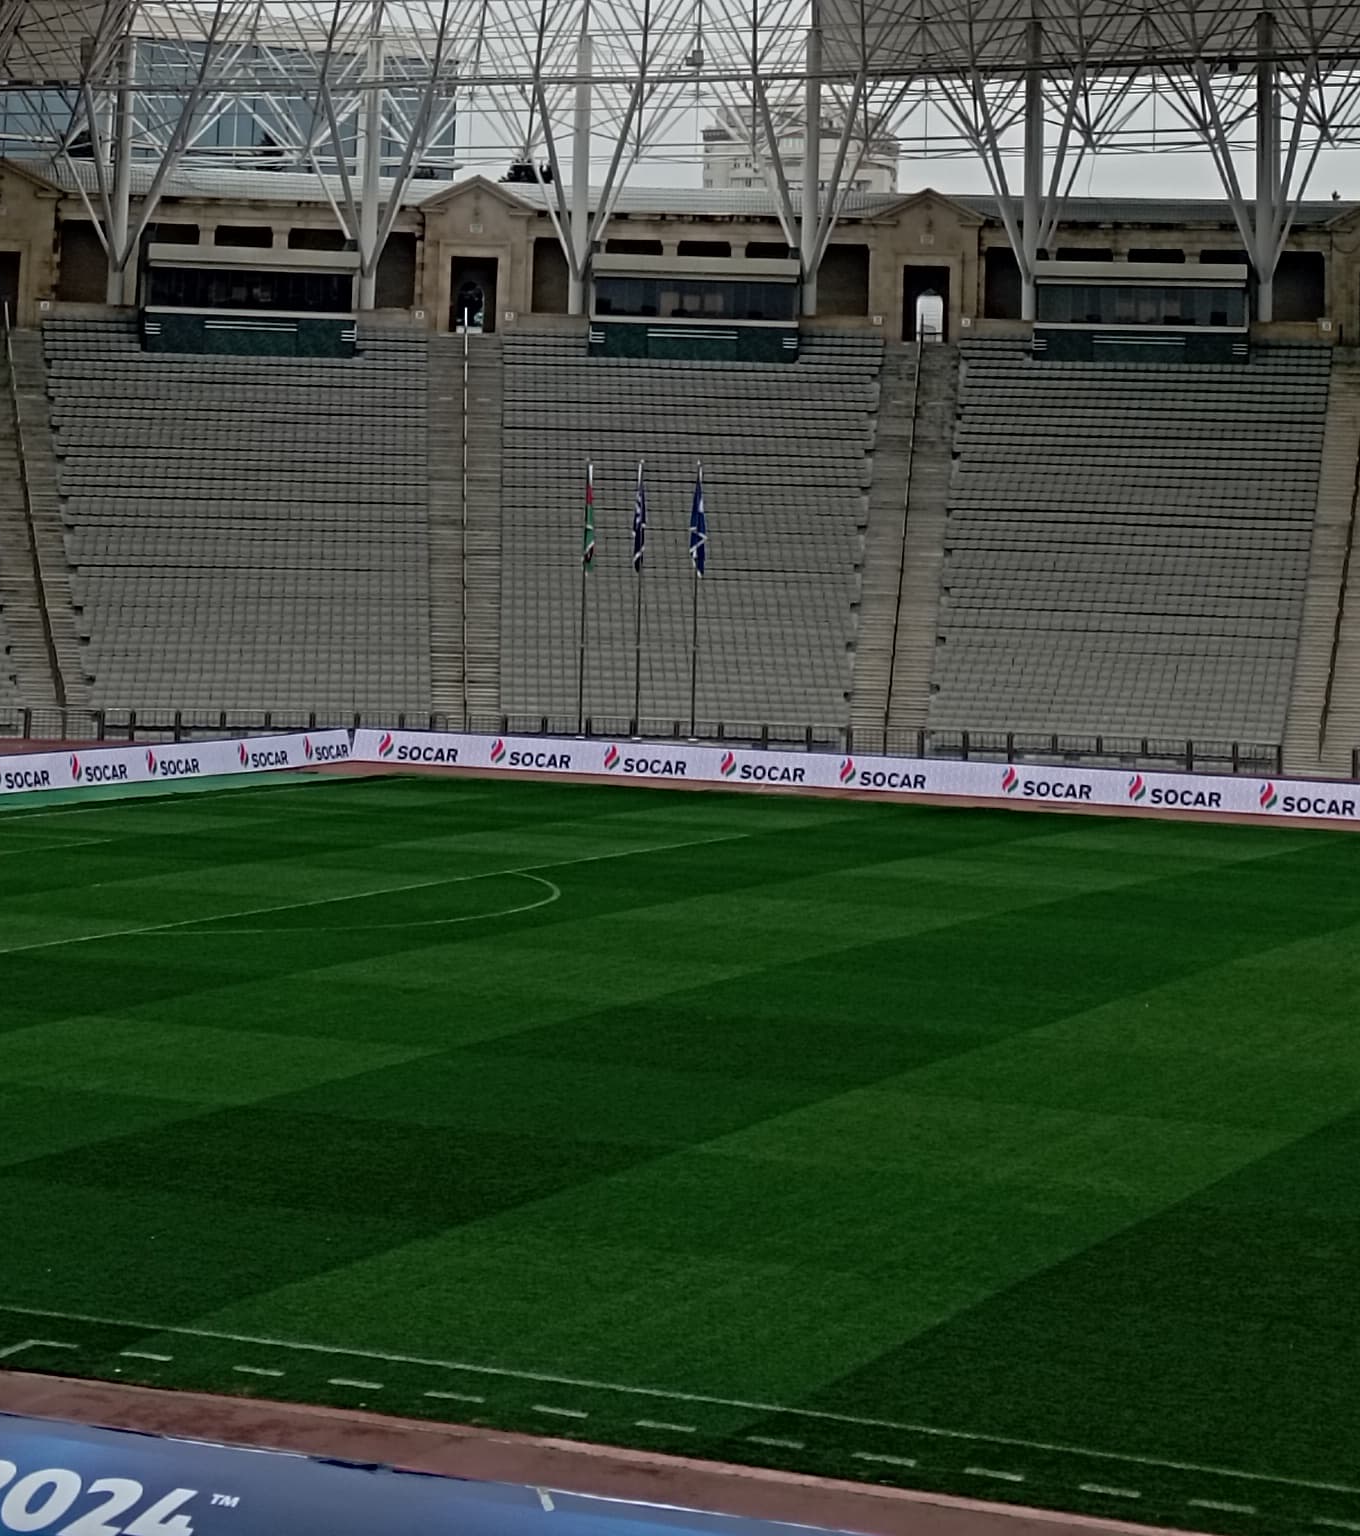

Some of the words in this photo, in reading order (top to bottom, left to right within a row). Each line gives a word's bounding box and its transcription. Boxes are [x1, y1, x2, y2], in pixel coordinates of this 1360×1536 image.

[252, 751, 288, 768] SOCAR
[315, 744, 348, 760] SOCAR
[398, 746, 458, 762] SOCAR
[509, 752, 570, 768] SOCAR
[85, 764, 127, 782] SOCAR
[160, 759, 199, 775] SOCAR
[624, 758, 686, 775] SOCAR
[741, 765, 805, 781] SOCAR
[5, 771, 50, 789] SOCAR
[860, 772, 925, 789] SOCAR
[1024, 781, 1091, 799] SOCAR
[1151, 789, 1221, 807] SOCAR
[1283, 797, 1355, 815] SOCAR
